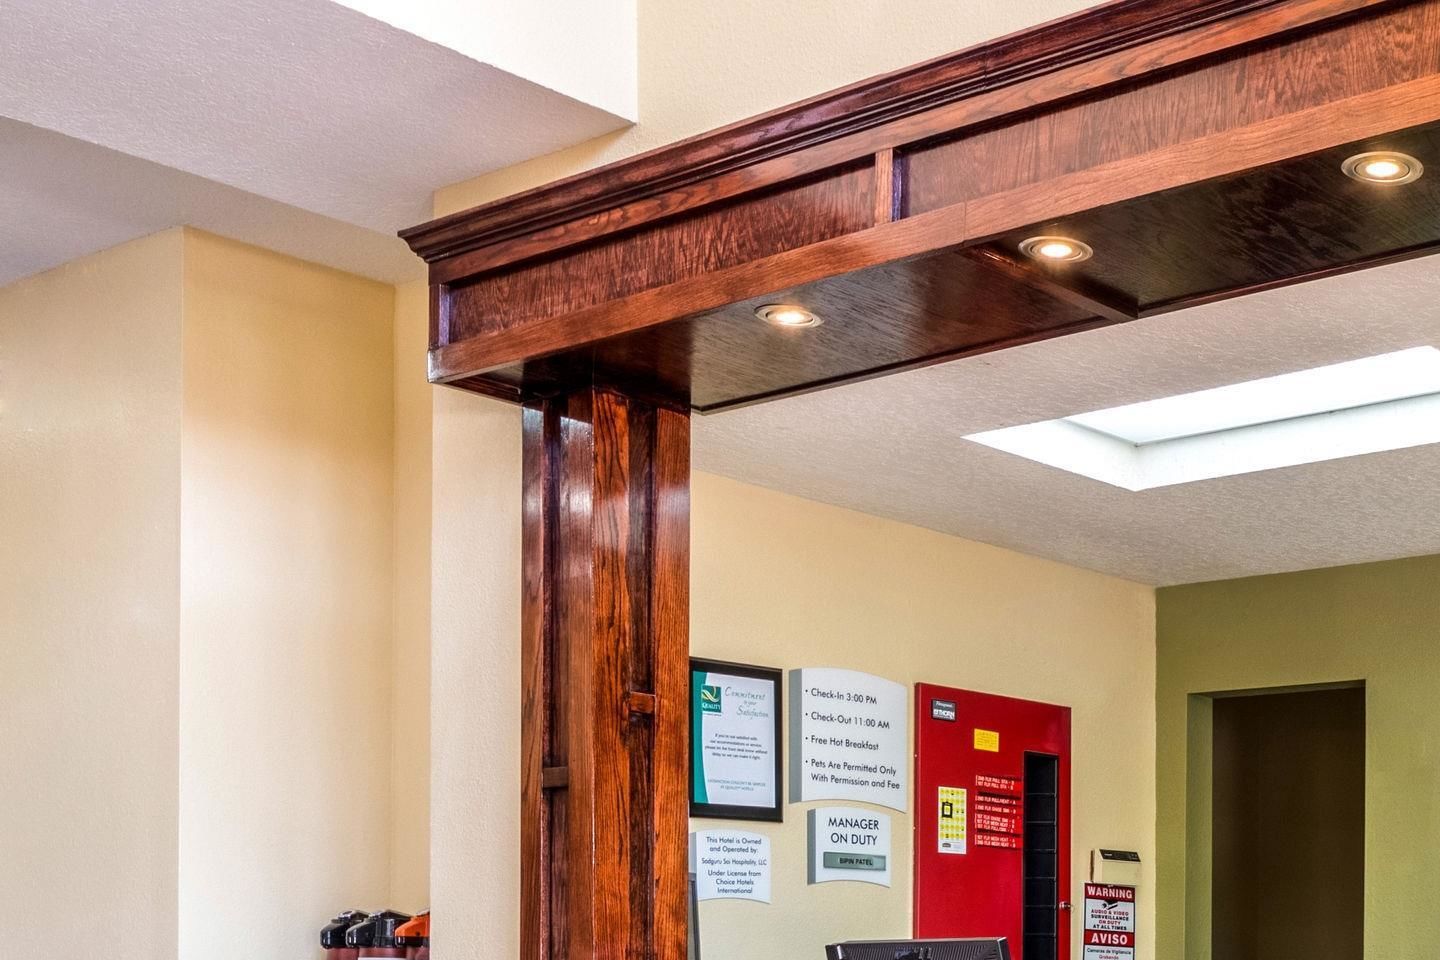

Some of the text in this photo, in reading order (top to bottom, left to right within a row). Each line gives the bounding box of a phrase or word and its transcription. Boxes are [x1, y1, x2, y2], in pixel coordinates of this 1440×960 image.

[811, 688, 877, 704] Check-In 3:00 PM
[811, 711, 890, 729] Check-Out 11:00 AM
[811, 735, 879, 750] Free Hot Breakfast
[811, 759, 896, 776] Pets Are Permitted Only
[811, 773, 900, 789] With Permission and Fee
[828, 817, 879, 830] MANAGER
[831, 833, 877, 845] ON DUTY
[1087, 886, 1132, 898] WARNING
[1091, 933, 1128, 945] AVISO
